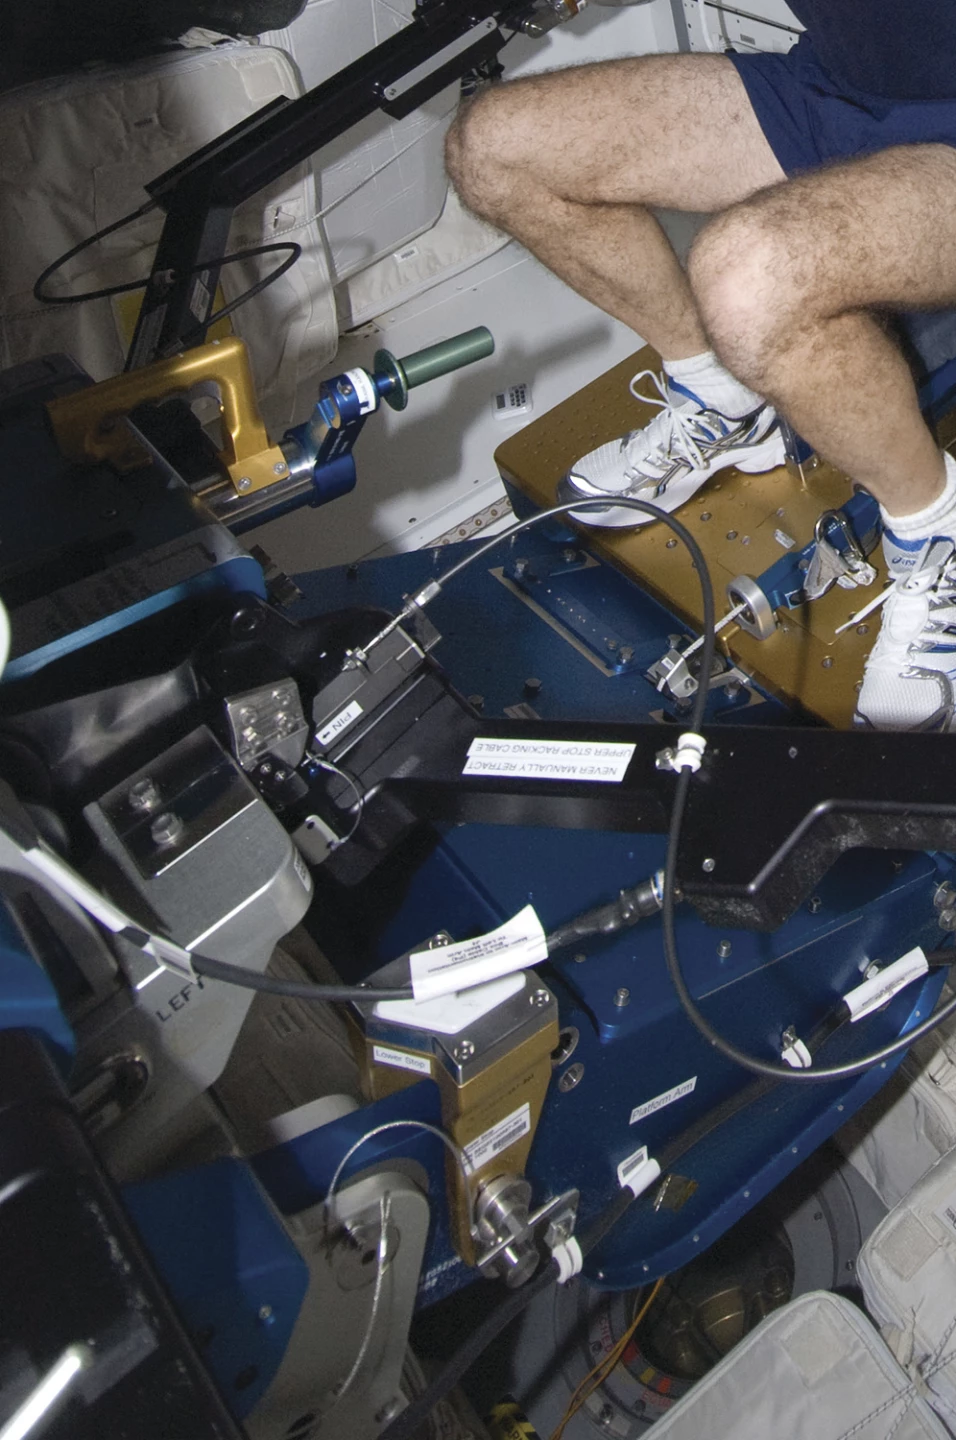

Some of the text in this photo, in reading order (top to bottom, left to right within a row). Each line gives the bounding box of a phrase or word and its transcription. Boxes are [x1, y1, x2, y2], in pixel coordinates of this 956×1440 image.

[332, 711, 352, 731] PIN
[475, 743, 632, 757] UPPER STOP RACKING CABLE
[467, 761, 618, 776] NEVER MANUALLY RETRACT
[156, 976, 205, 1023] LEFT
[375, 1048, 426, 1069] Lower Stop
[632, 1082, 693, 1120] Platform Arm
